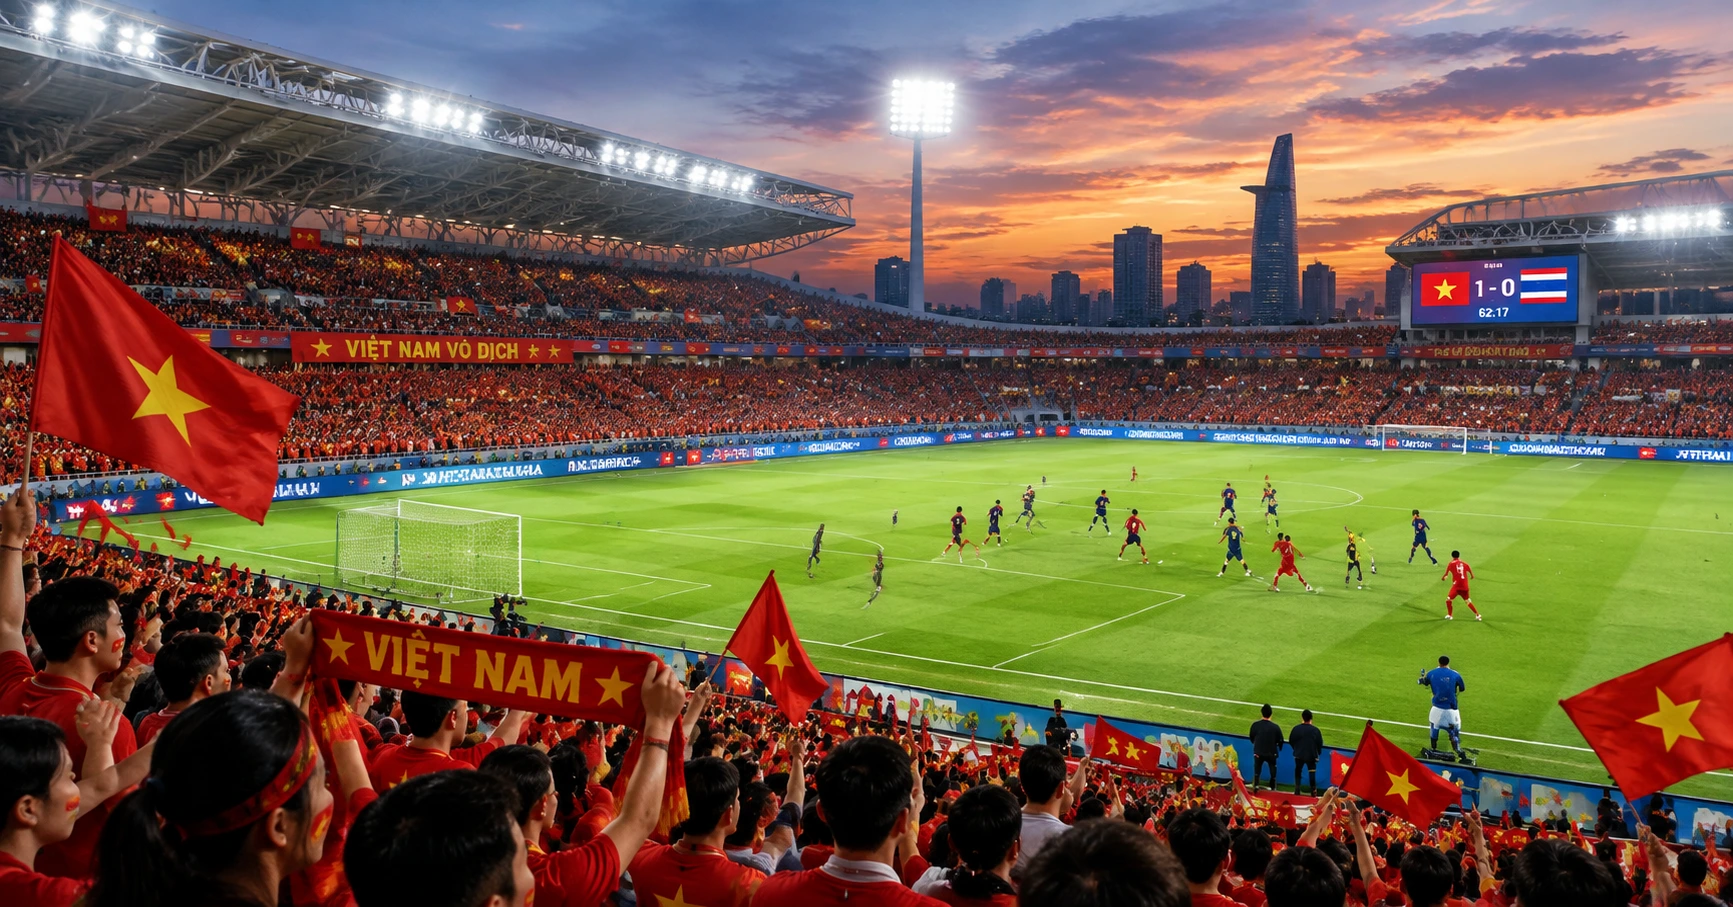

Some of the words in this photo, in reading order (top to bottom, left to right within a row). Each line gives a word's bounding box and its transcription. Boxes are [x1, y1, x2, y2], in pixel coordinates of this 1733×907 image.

[345, 334, 392, 360] VIỆT
[399, 340, 440, 358] NAM
[478, 342, 519, 363] DỊCH
[364, 629, 460, 689] VIỆT
[473, 649, 583, 703] NAM
